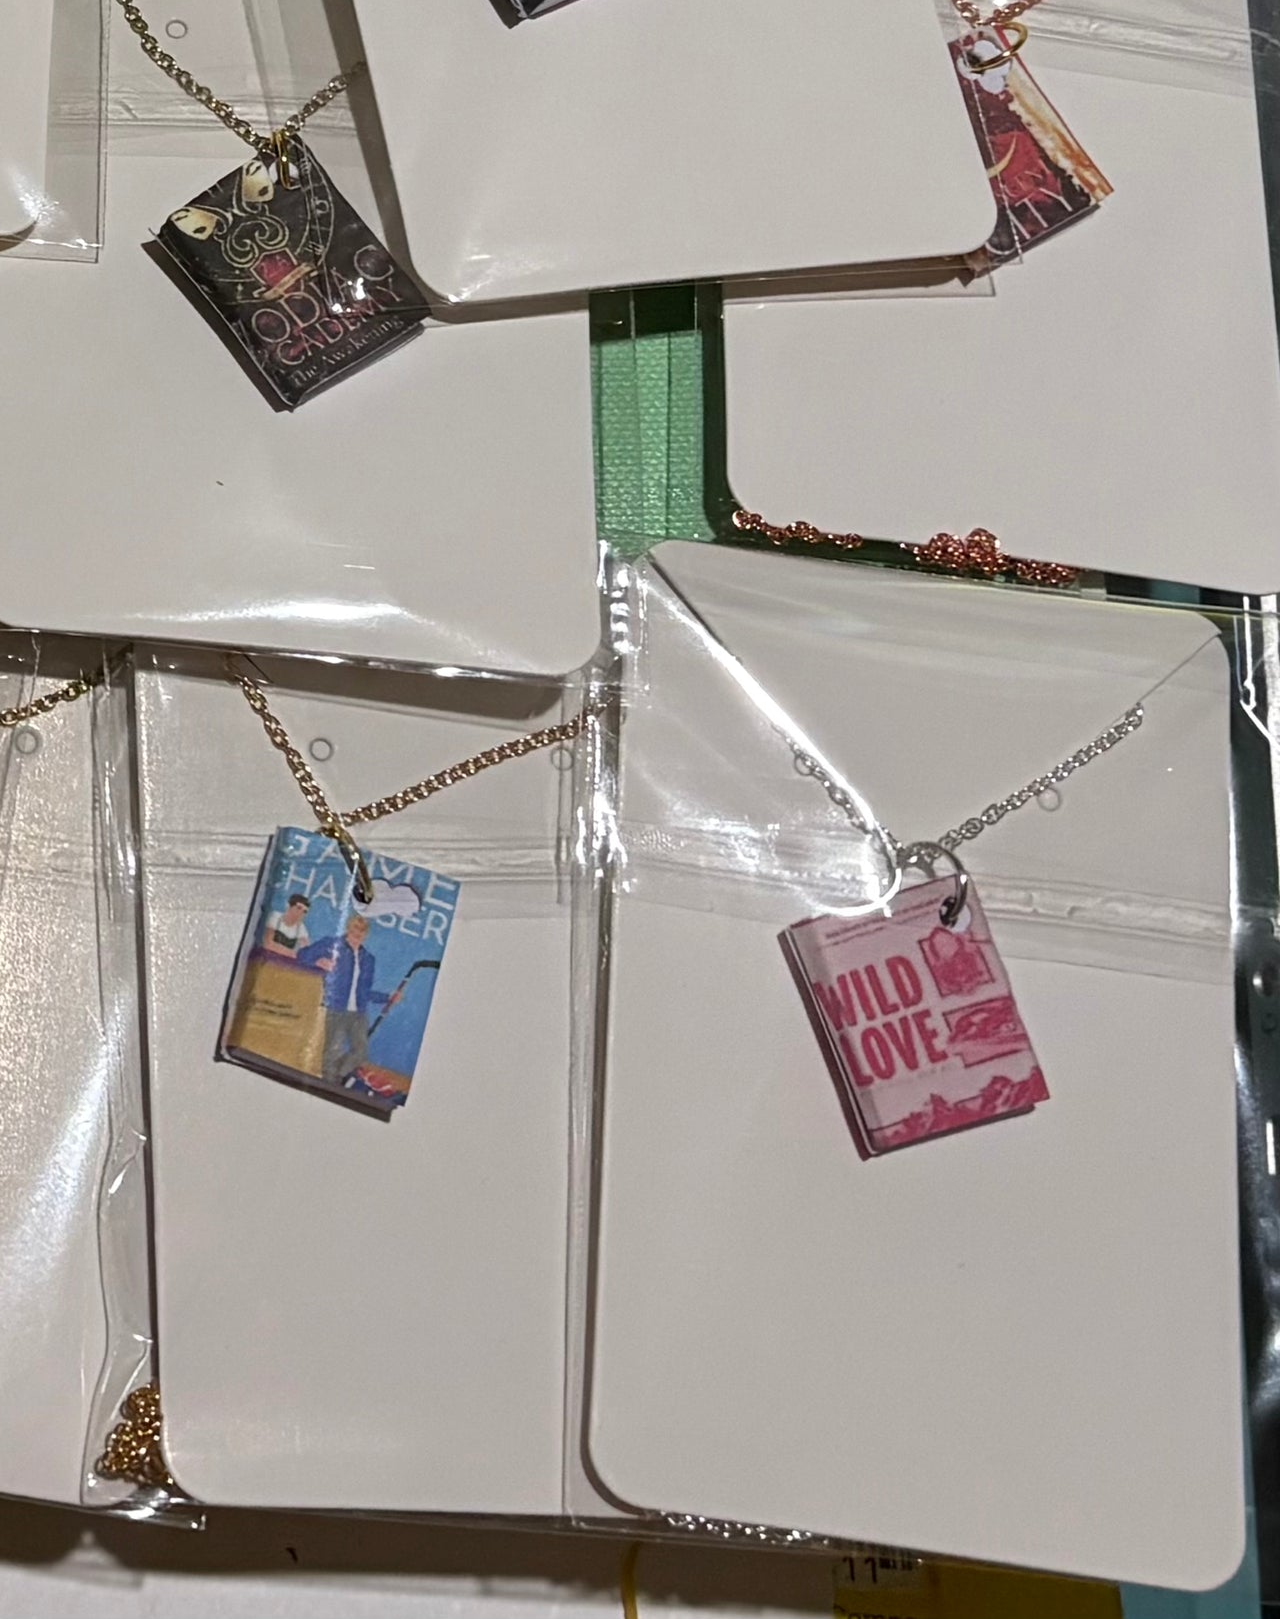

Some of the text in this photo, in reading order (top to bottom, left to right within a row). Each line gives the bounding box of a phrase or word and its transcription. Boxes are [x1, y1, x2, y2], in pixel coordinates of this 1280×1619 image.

[240, 243, 395, 344] ODIAC
[274, 277, 405, 367] CADEMY
[814, 954, 924, 1032] WILD
[840, 1008, 949, 1088] LOVE
